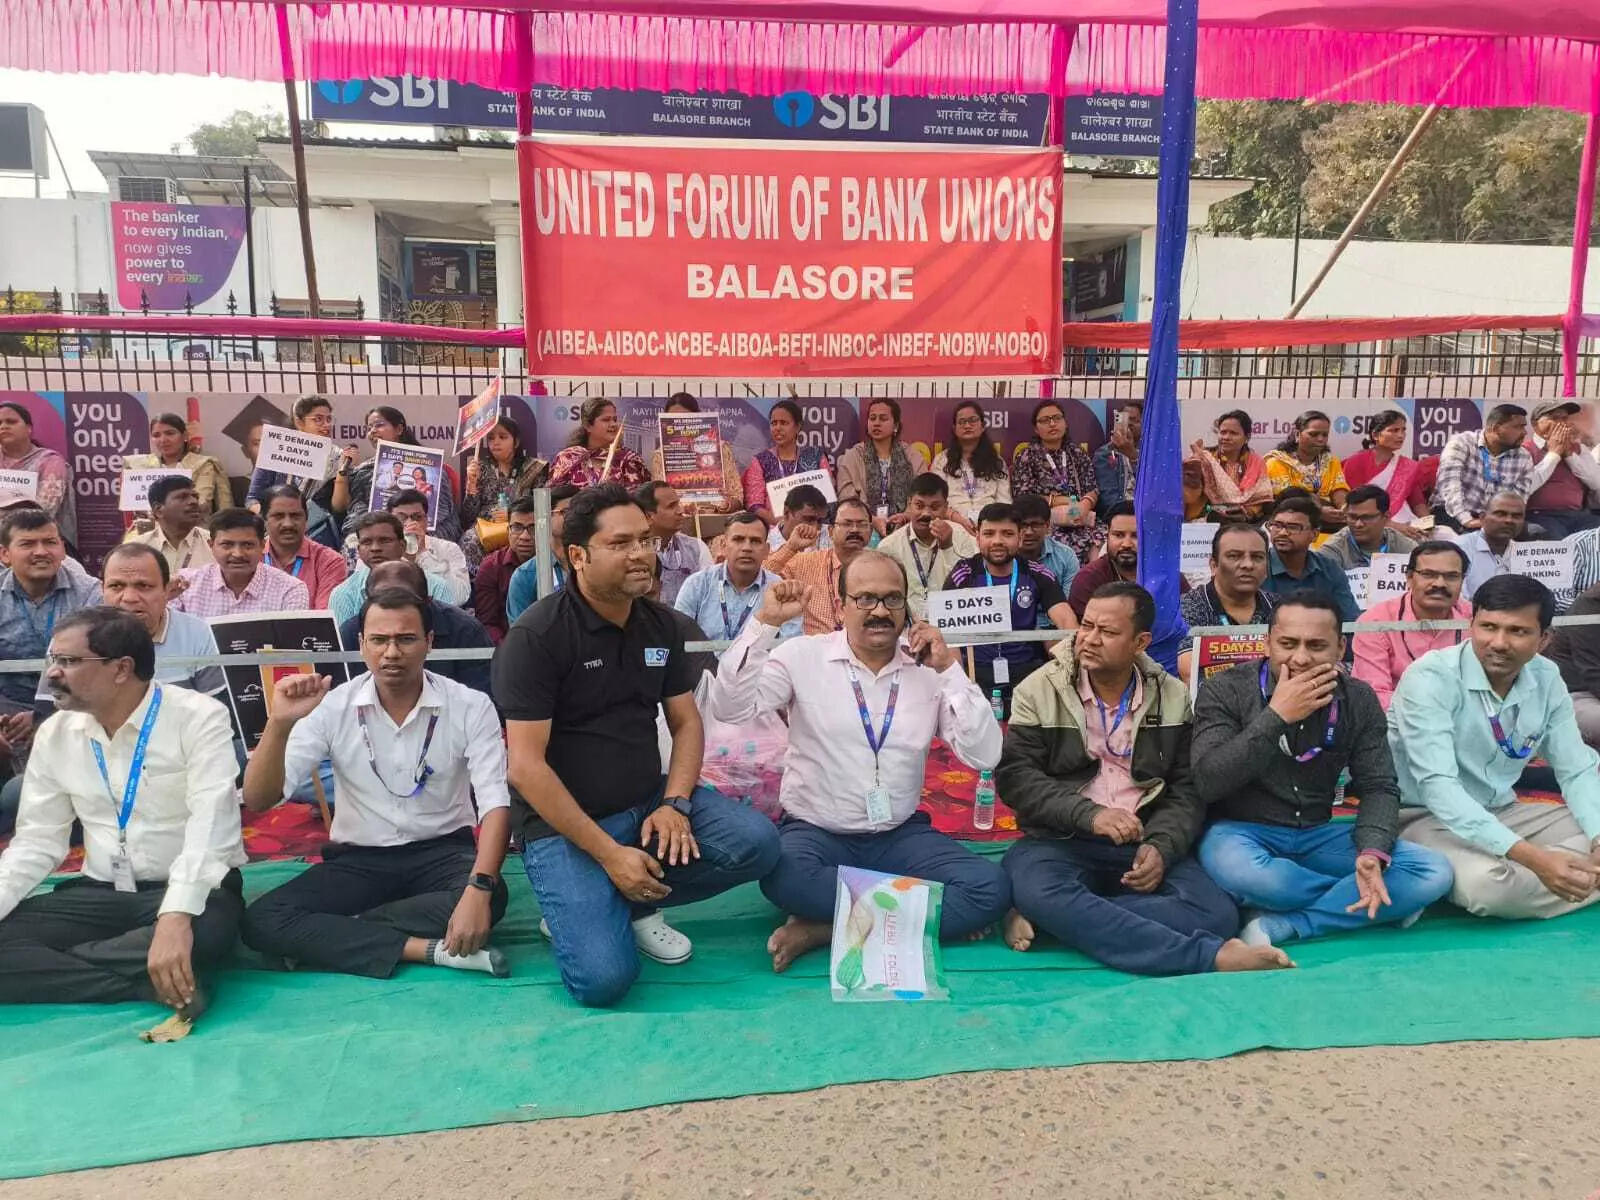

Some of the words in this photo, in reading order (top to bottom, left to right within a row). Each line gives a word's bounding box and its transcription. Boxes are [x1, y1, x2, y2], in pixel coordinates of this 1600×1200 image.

[369, 72, 448, 108] SBI
[488, 103, 515, 114] STAT
[532, 105, 555, 116] ANK
[559, 107, 573, 117] OF
[576, 108, 606, 119] INDIA
[819, 94, 889, 131] SBI
[653, 112, 706, 125] BALASORE
[709, 115, 751, 128] BRANCH
[923, 125, 954, 135] STATE
[956, 127, 984, 137] BANK
[987, 128, 1000, 137] OF
[1002, 129, 1029, 138] INDIA
[1072, 131, 1120, 142] BALASORE
[1122, 133, 1160, 143] BRANCH
[534, 168, 655, 238] UNITED
[666, 173, 780, 241] FORUM
[790, 175, 830, 242] OF
[841, 177, 929, 243] BANK
[939, 175, 1056, 243] UNIONS
[122, 209, 149, 222] The
[152, 210, 200, 223] banker
[123, 225, 138, 237] to
[141, 228, 179, 240] every
[182, 225, 228, 240] Indian,
[124, 244, 152, 254] now
[157, 243, 192, 256] gives
[125, 259, 168, 270] power
[171, 258, 185, 269] to
[126, 273, 164, 285] every
[687, 264, 914, 301] BALASORE
[72, 403, 122, 427] you
[632, 407, 653, 416] NAYI
[1421, 407, 1461, 428] you
[420, 425, 455, 440] LOAN
[667, 425, 674, 434] 5
[73, 423, 131, 453] only
[268, 431, 282, 440] WE
[284, 435, 324, 449] DEMAND
[796, 425, 844, 453] only
[286, 446, 310, 457] DAYS
[75, 450, 137, 473] nee
[270, 453, 313, 468] BANKING
[1530, 547, 1568, 556] DEMAND
[1387, 563, 1396, 573] 5
[1533, 559, 1556, 567] DAYS
[945, 600, 953, 610] 5
[957, 596, 993, 609] DAYS
[937, 612, 1003, 629] BANKING
[1208, 642, 1219, 654] 5
[1220, 642, 1254, 653] DAYS
